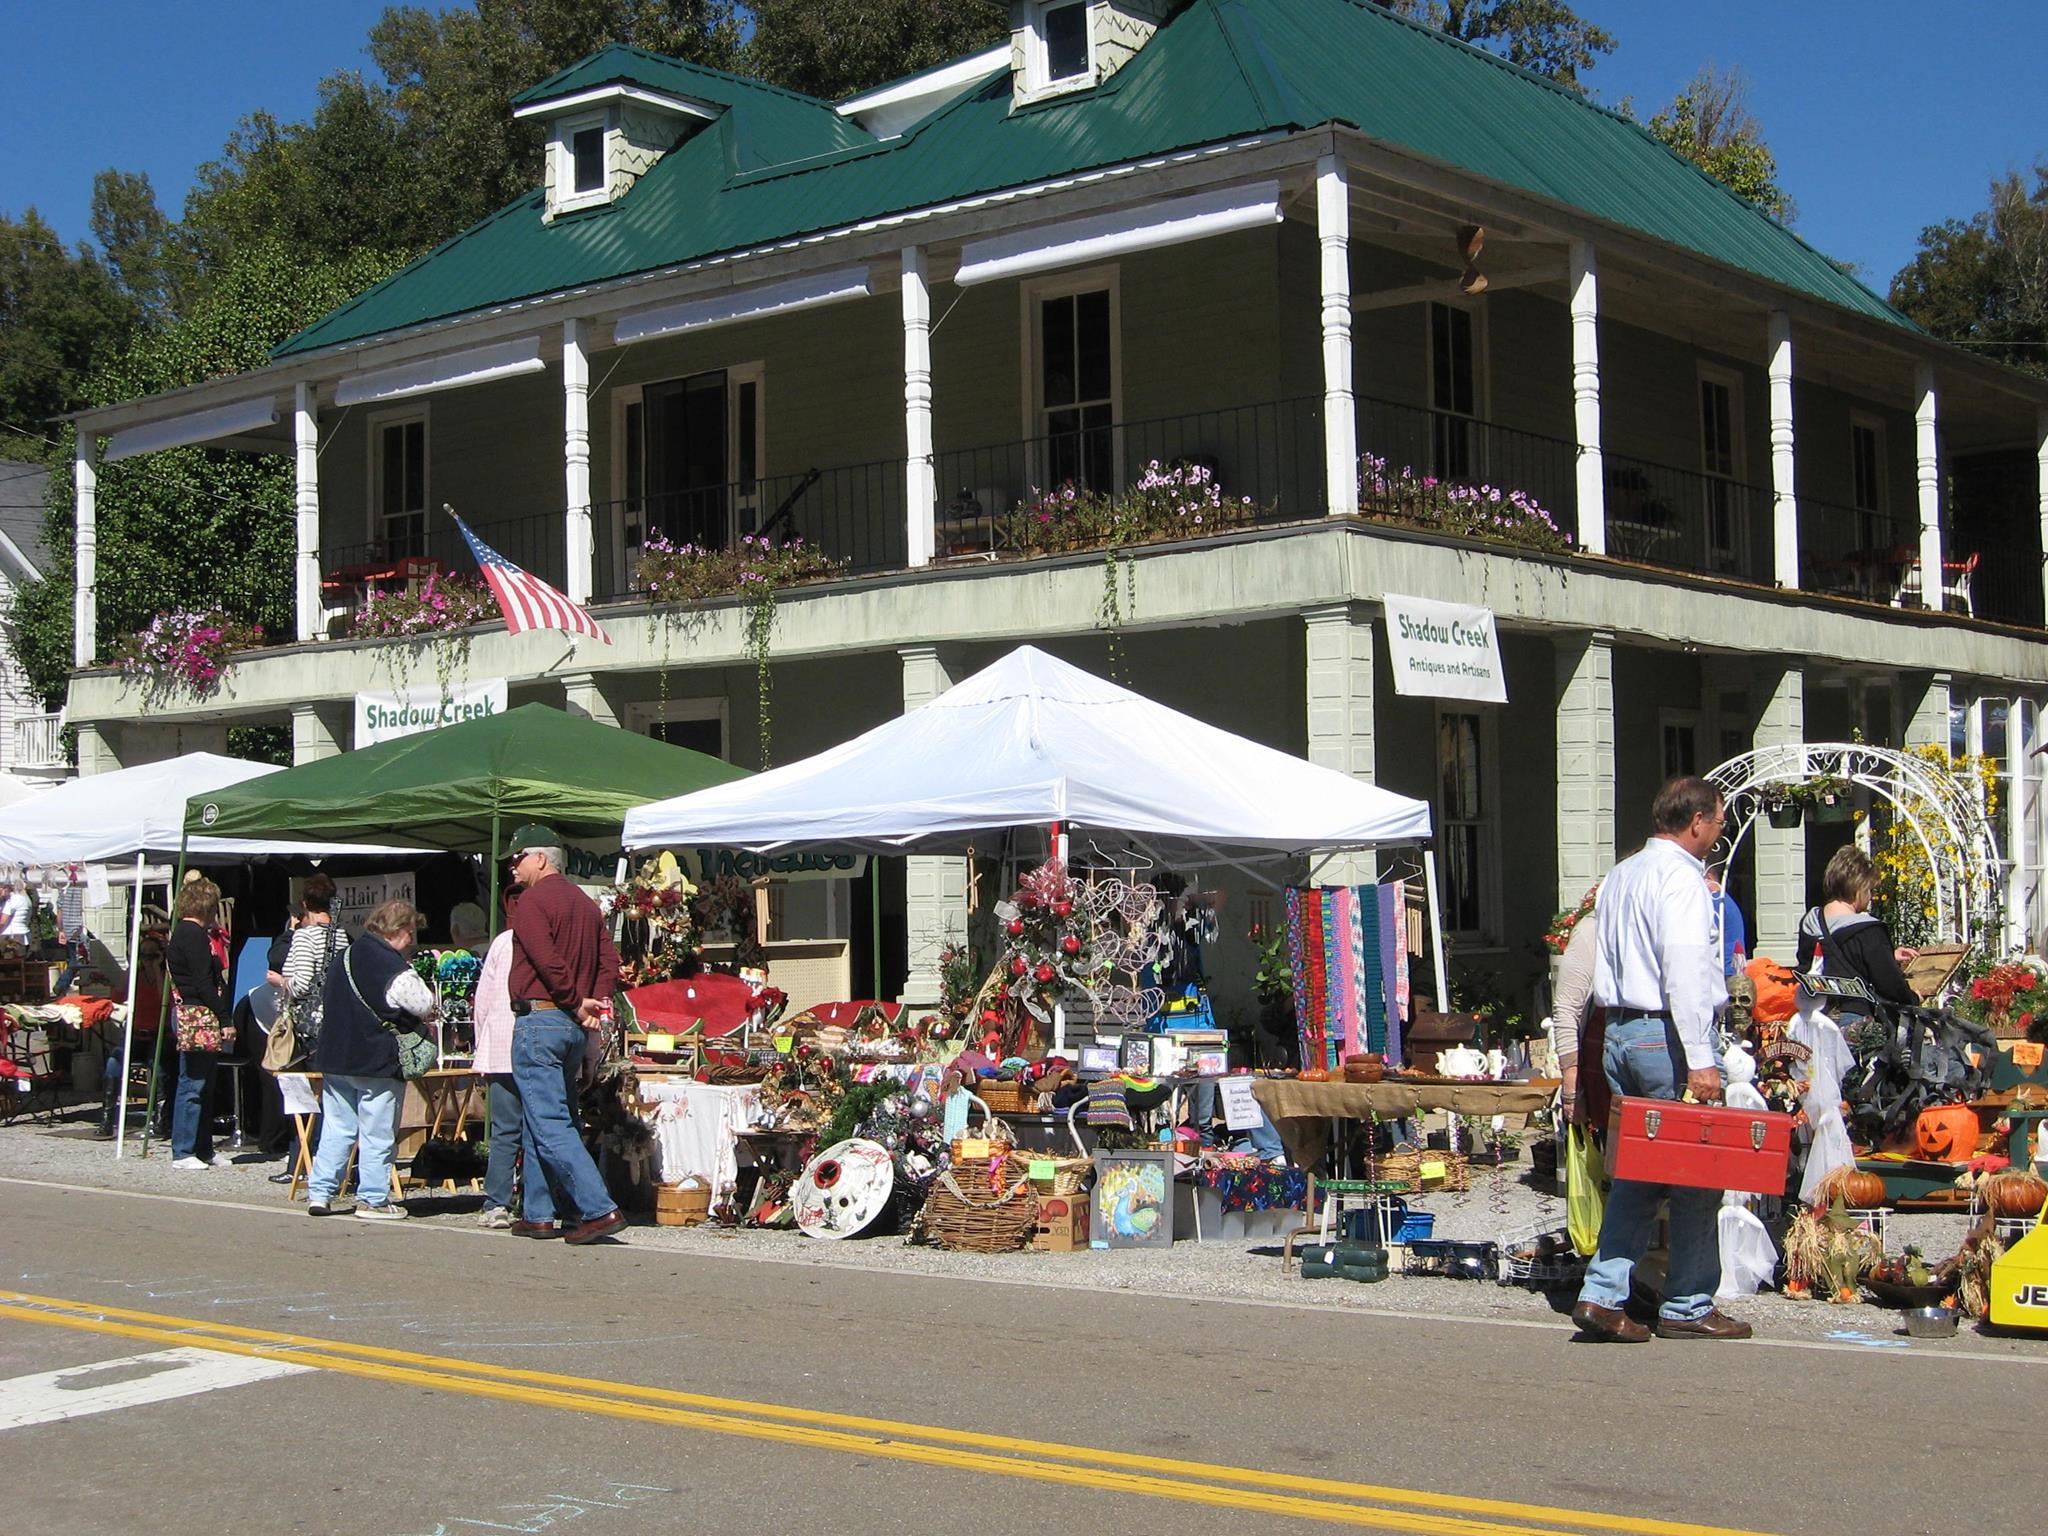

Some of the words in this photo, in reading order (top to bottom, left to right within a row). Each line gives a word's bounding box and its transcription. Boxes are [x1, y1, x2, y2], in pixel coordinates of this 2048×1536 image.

[1398, 613, 1448, 645] Shadow
[1452, 620, 1490, 649] Creek
[1409, 657, 1446, 677] Antiques
[1447, 661, 1461, 675] and
[1462, 662, 1491, 679] Artisans
[366, 704, 436, 729] Shadow
[441, 694, 496, 723] Creek
[345, 885, 378, 906] Hair
